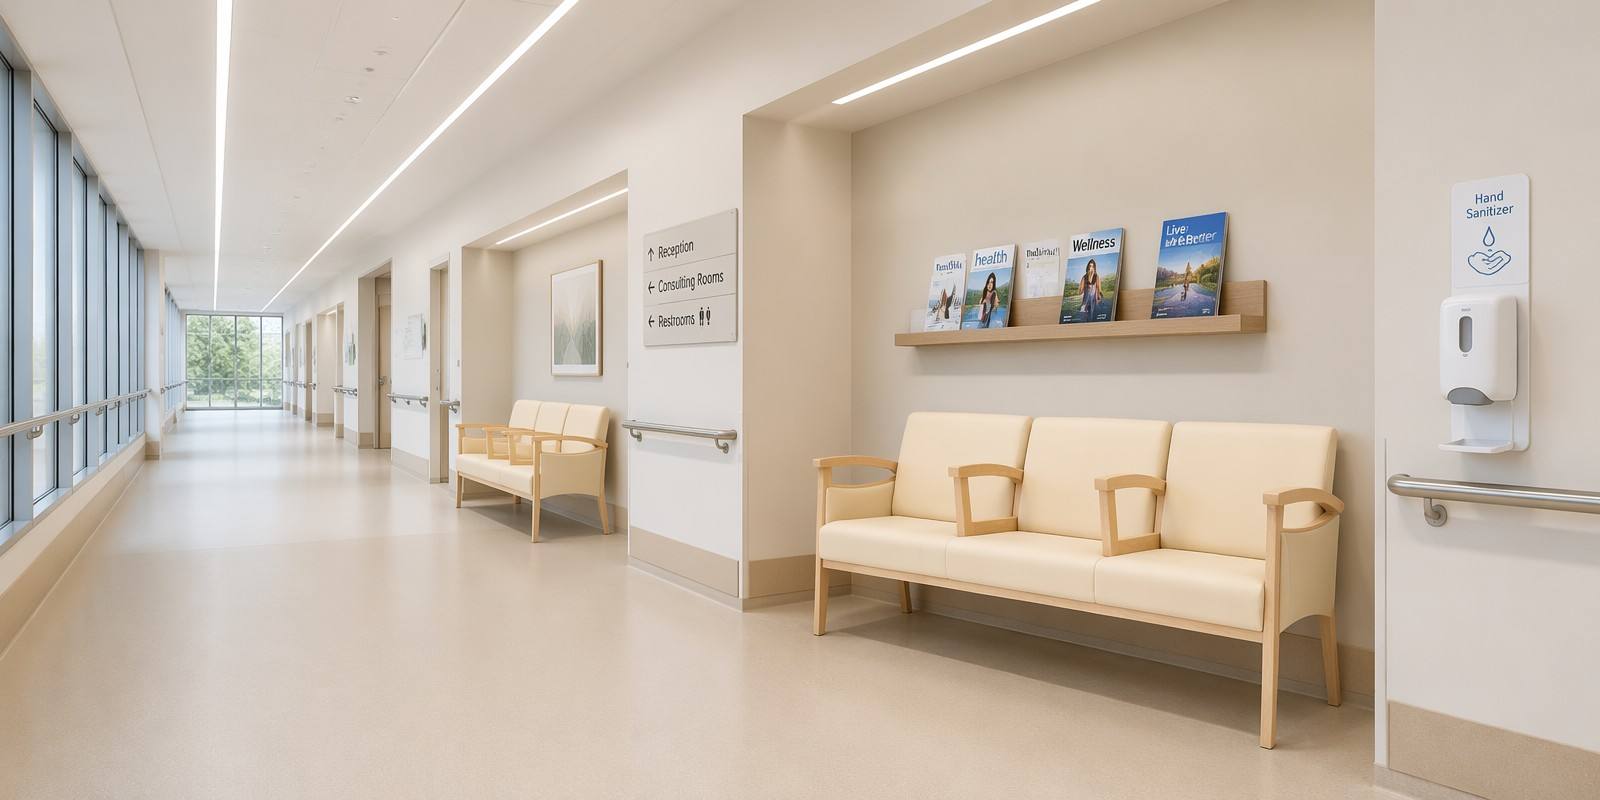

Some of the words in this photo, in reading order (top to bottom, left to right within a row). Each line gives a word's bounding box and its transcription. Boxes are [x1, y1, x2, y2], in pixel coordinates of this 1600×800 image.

[1475, 189, 1504, 205] Hand
[1466, 204, 1514, 219] Sanitizer
[658, 240, 694, 259] Reception
[1072, 237, 1116, 252] Wellness
[658, 276, 695, 293] Consulting
[697, 271, 724, 286] Rooms
[658, 314, 695, 328] Restrooms
